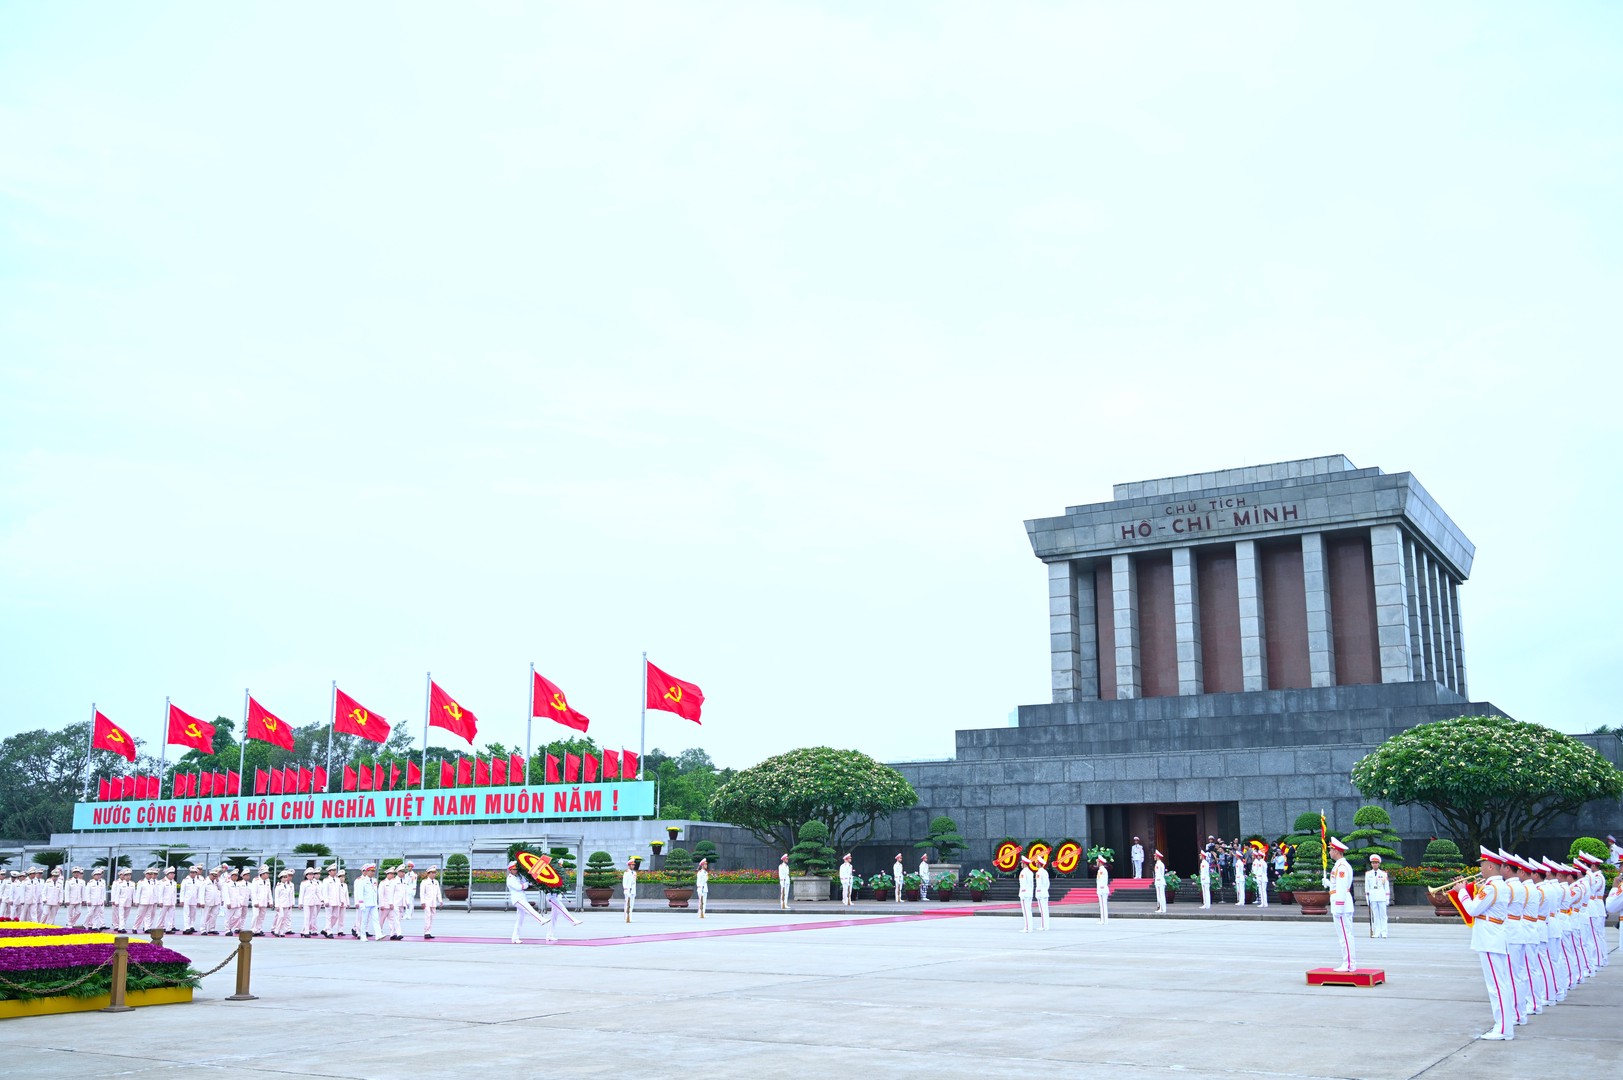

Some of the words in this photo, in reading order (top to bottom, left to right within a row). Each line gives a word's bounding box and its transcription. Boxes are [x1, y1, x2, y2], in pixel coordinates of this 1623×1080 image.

[1121, 519, 1152, 540] HỒ
[1172, 511, 1211, 534] CHÍ
[1233, 505, 1298, 527] MINH
[1165, 500, 1197, 515] CHỦ
[1208, 497, 1246, 512] TỊCH
[93, 804, 131, 825] NƯỚC
[136, 802, 177, 827] CỘNG
[182, 801, 213, 823] HÒA
[219, 800, 240, 822] XÃ
[246, 798, 275, 824] HỘI
[281, 795, 315, 820] CHỦ
[321, 795, 376, 819] NGHĨA
[385, 793, 425, 820] VIỆT
[433, 795, 477, 816] NAM
[485, 788, 545, 815] MUÔN
[553, 786, 603, 814] NĂM
